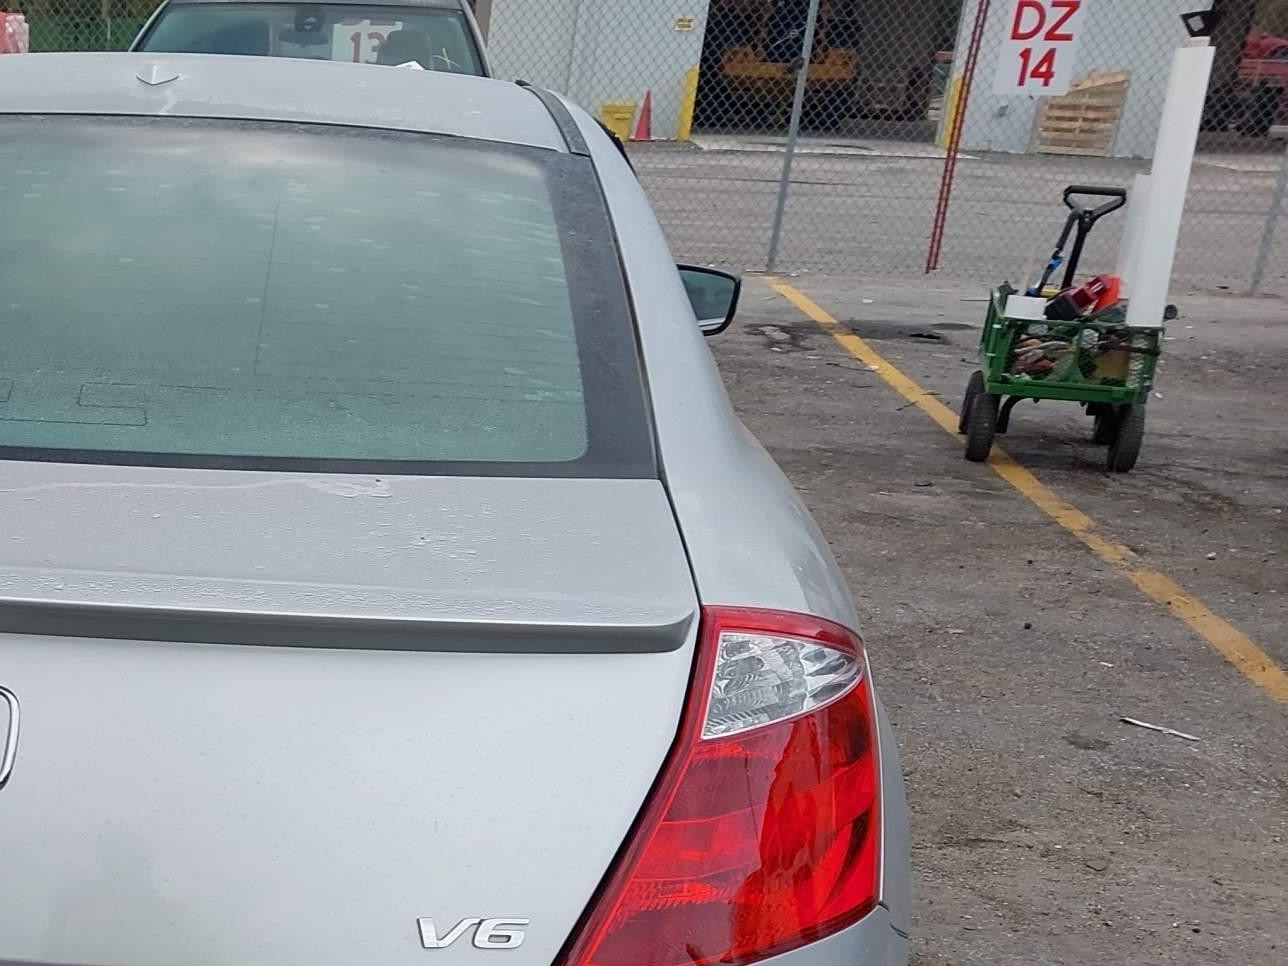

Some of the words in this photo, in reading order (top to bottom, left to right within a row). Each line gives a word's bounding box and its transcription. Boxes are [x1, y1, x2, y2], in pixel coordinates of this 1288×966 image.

[1010, 0, 1081, 41] DZ
[1017, 47, 1057, 87] 14
[416, 916, 531, 950] V6
